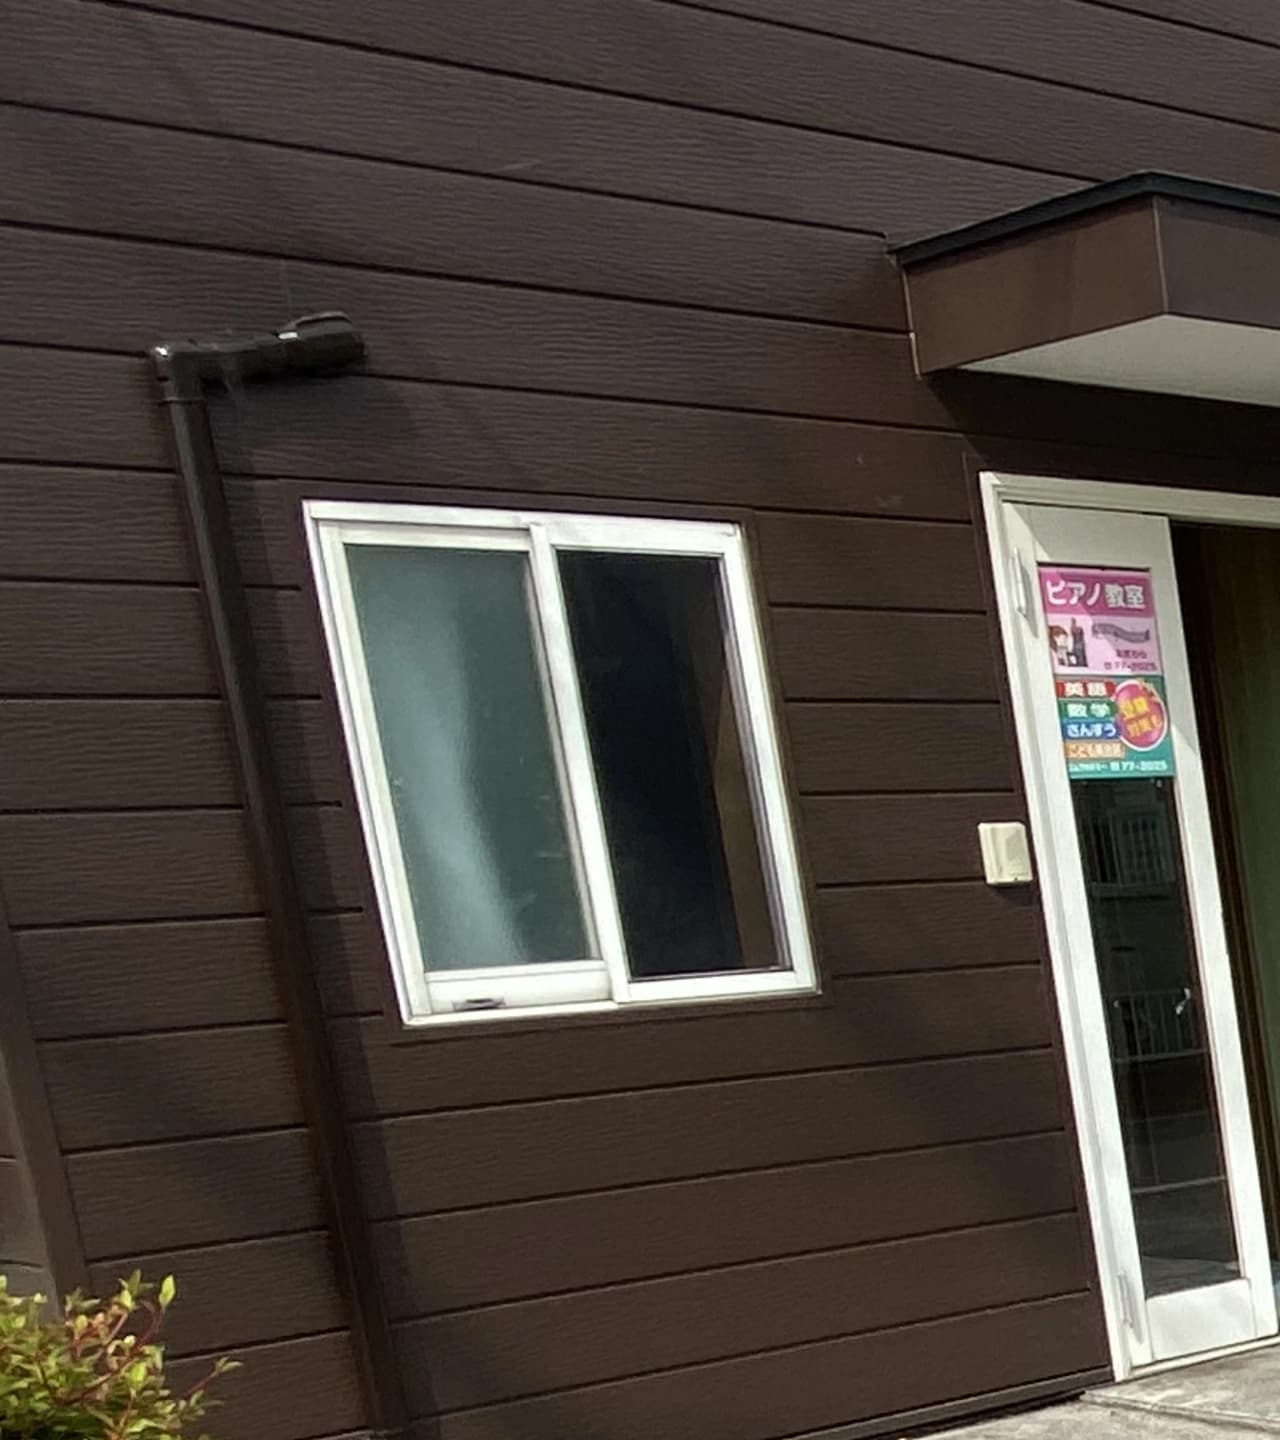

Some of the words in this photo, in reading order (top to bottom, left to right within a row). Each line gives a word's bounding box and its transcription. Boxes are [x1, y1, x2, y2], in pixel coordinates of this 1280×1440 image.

[1046, 580, 1146, 609] ピアノ教室
